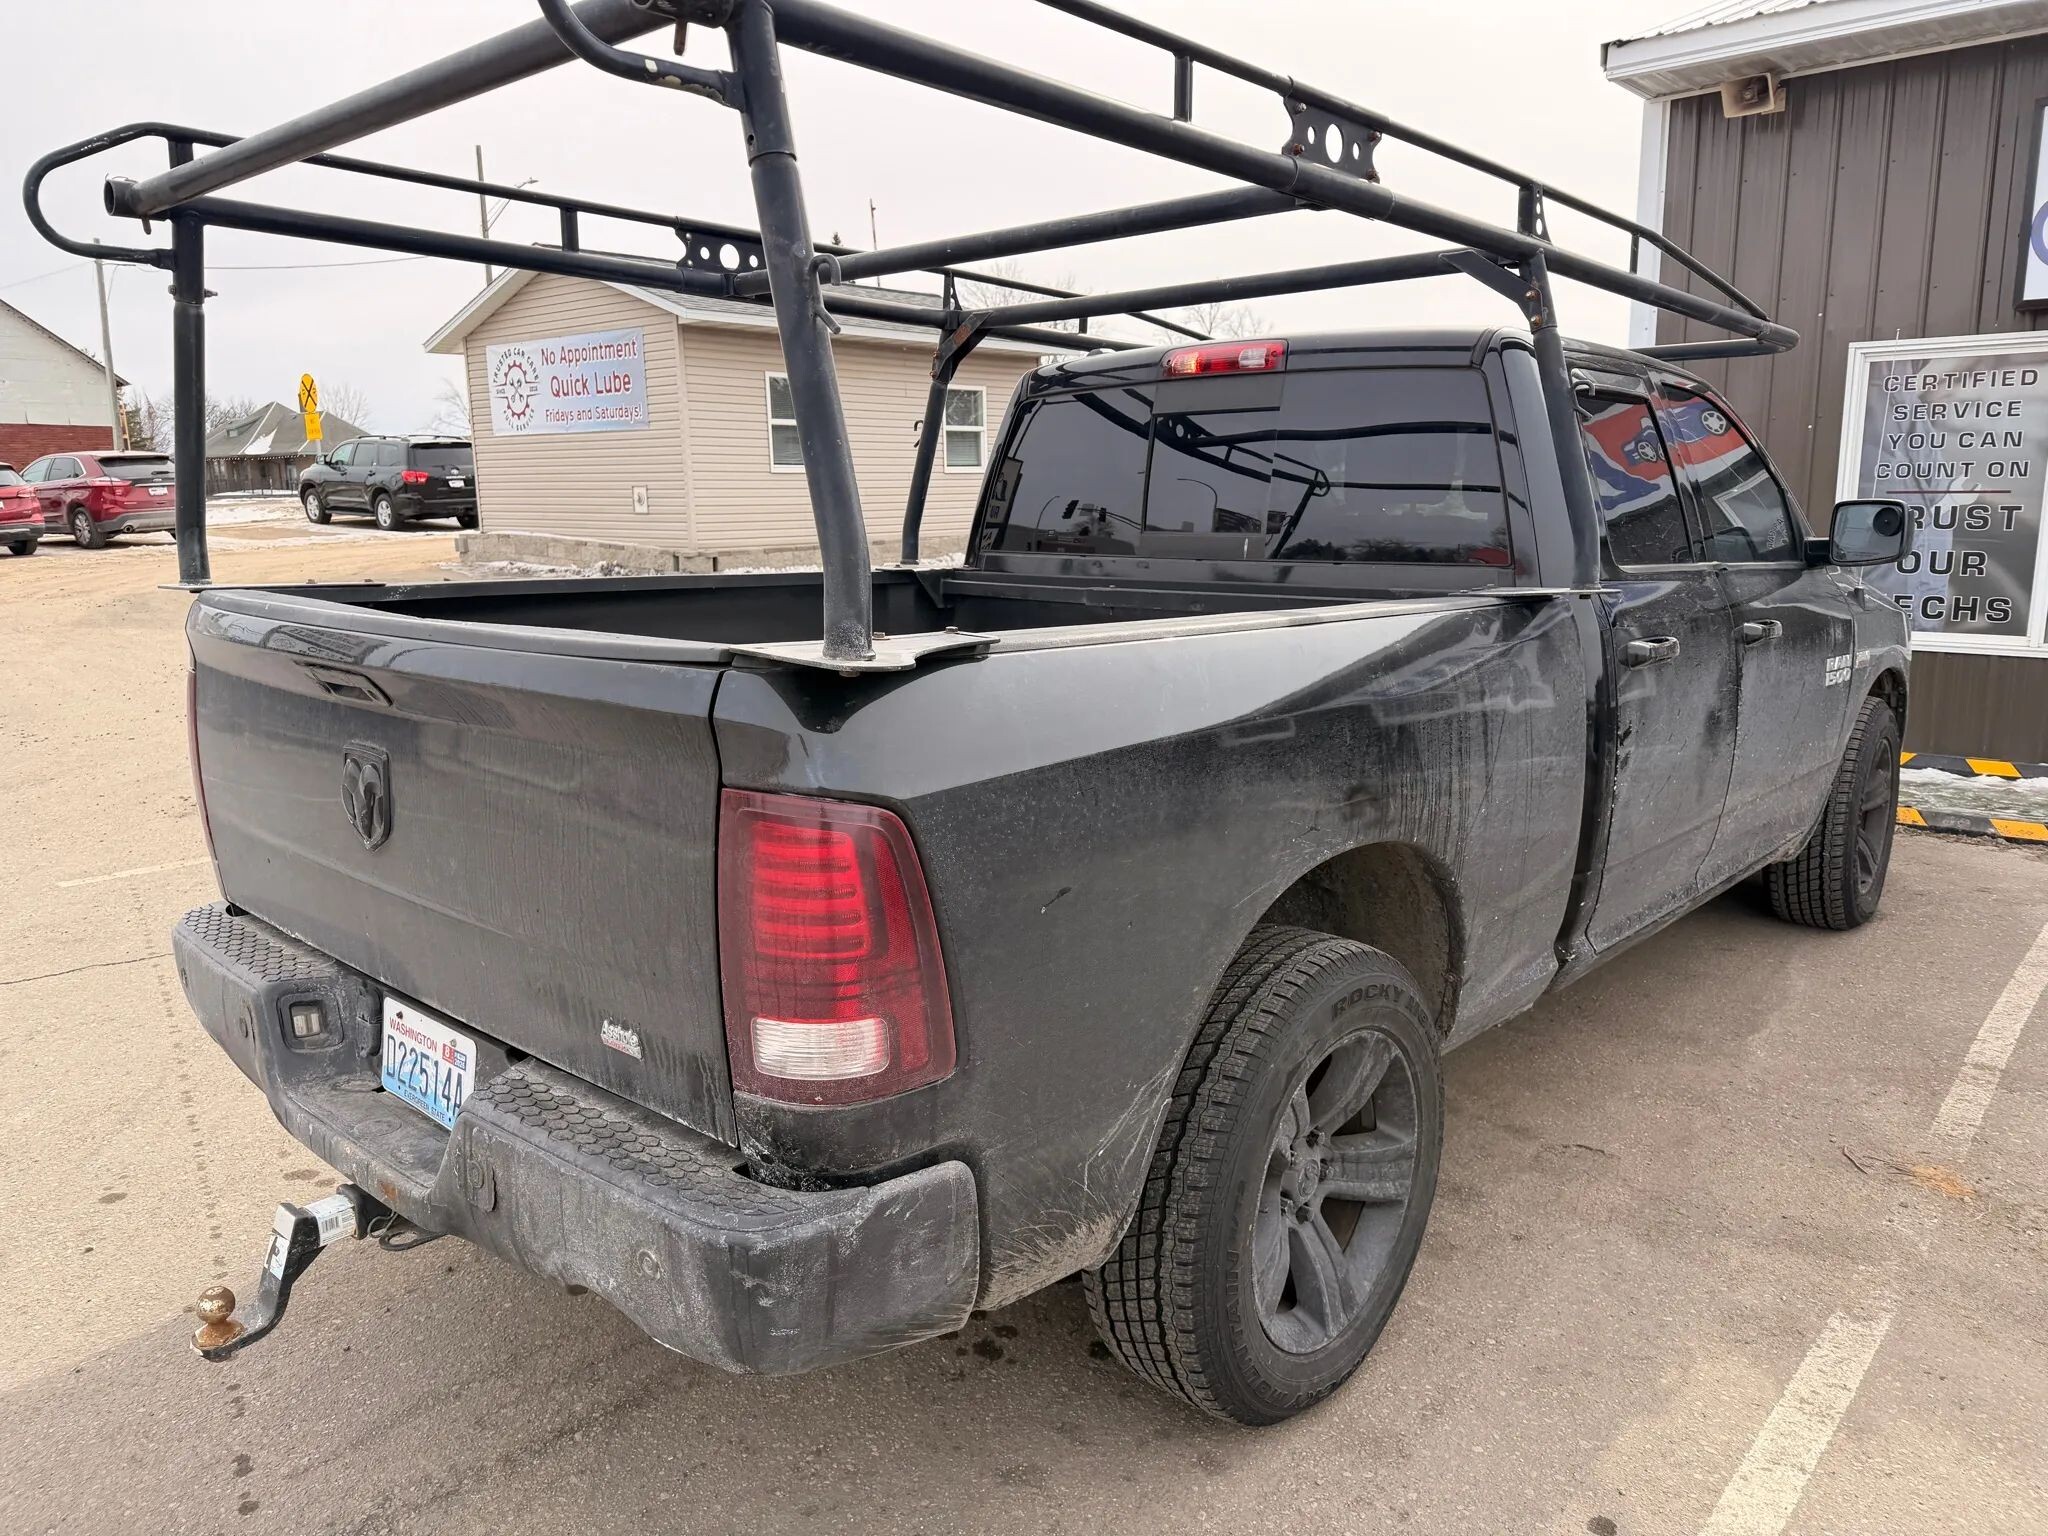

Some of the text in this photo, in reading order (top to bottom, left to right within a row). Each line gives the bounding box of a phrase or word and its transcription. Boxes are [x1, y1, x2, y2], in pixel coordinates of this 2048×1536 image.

[513, 347, 525, 357] CAR
[541, 341, 637, 368] No Appointment
[550, 370, 631, 398] Quick Lube
[1884, 369, 2039, 392] CERTIFIED
[545, 403, 643, 425] Fridays and Saturdays!
[1893, 400, 2022, 420] SERVICE
[1888, 431, 2024, 450] YOU CAN
[1876, 461, 2030, 479] COUNT ON
[1908, 505, 2024, 531] RUST
[1895, 550, 1988, 576] OUR
[1893, 594, 2012, 623] ECHS
[1331, 984, 1405, 1020] ROCKY
[390, 1017, 438, 1052] WASHINGTON
[386, 1034, 463, 1117] D22514A
[404, 1089, 446, 1120] EVERGREEN STATE
